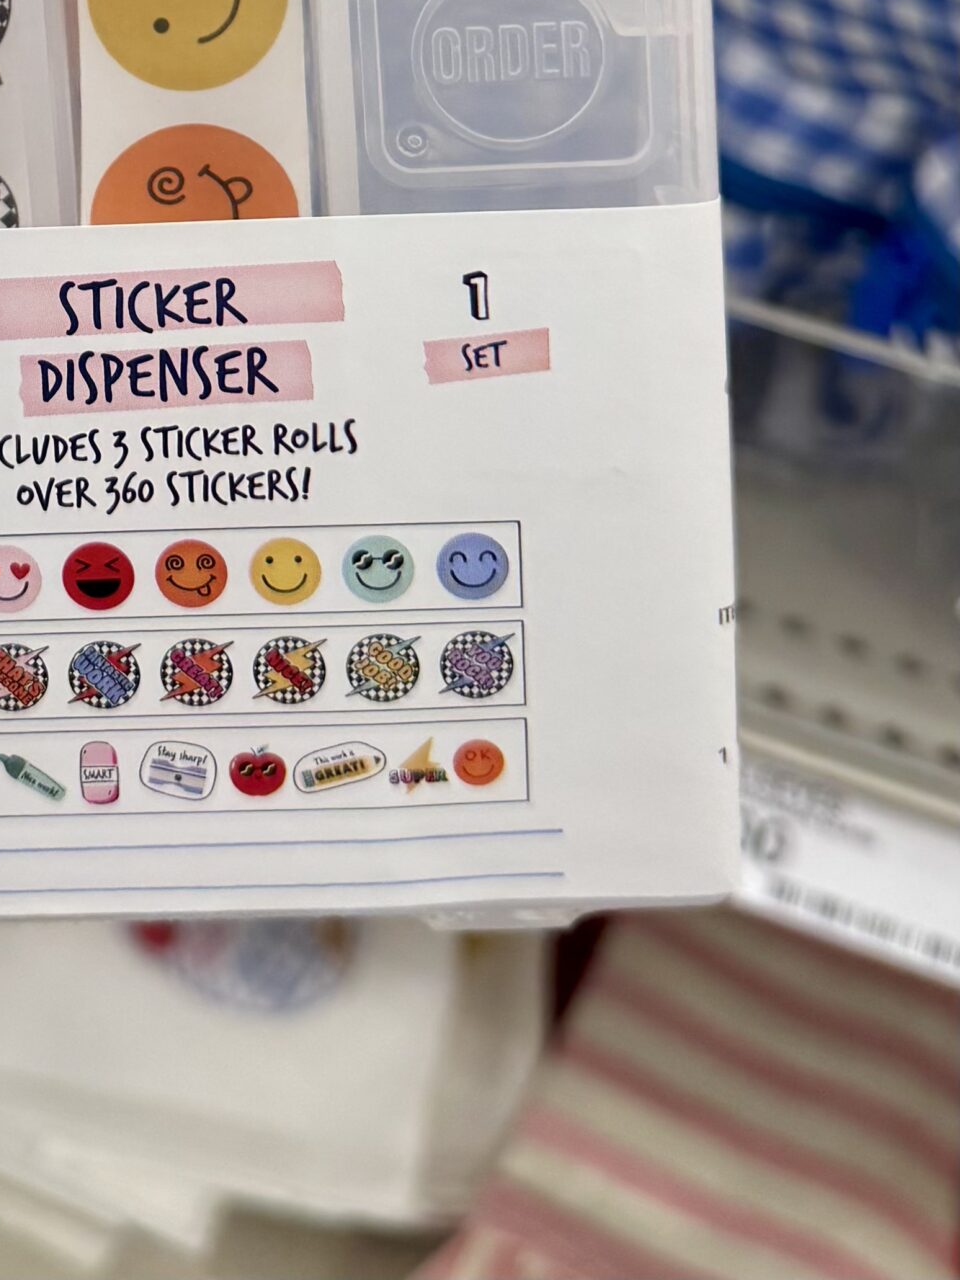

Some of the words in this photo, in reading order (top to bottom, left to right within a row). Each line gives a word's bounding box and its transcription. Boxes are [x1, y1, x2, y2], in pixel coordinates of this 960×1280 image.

[430, 20, 592, 84] ORDER
[58, 277, 249, 336] STICKER
[462, 270, 490, 321] 1
[37, 346, 280, 406] DISPENSER
[461, 340, 508, 372] SET
[111, 431, 129, 471] 3
[140, 422, 263, 461] STICKER
[273, 418, 358, 456] ROLLS
[16, 477, 97, 512] OVER
[104, 472, 155, 515] 360
[167, 466, 311, 507] STICKERS!
[367, 641, 414, 681] GOOD
[83, 768, 114, 780] SMART
[157, 745, 176, 762] Stay
[390, 767, 449, 784] SUPER
[464, 749, 491, 762] OK
